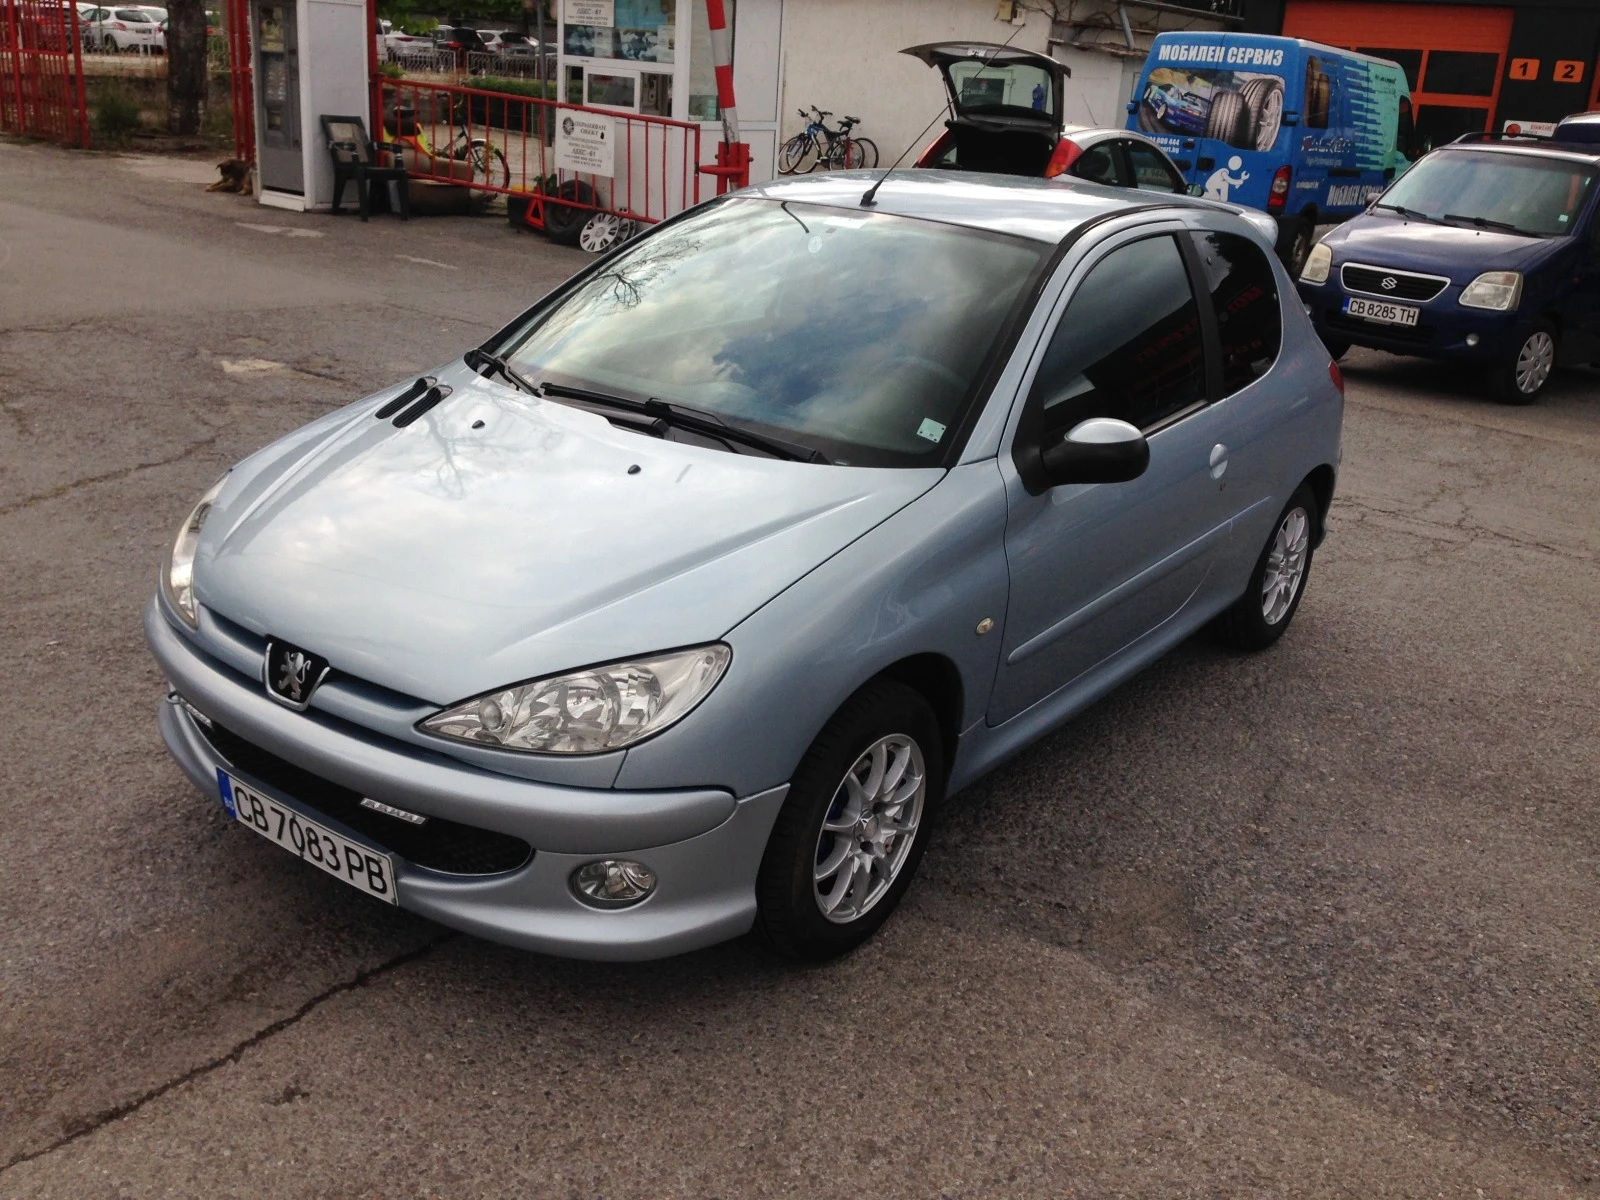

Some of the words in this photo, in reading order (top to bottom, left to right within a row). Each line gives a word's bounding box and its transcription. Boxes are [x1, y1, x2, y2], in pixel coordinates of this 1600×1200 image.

[1158, 44, 1226, 63] МОБИЛЕН
[1227, 46, 1284, 67] СЕРВИЗ
[1519, 62, 1529, 77] 1
[1561, 64, 1576, 79] 2
[1349, 300, 1365, 315] CB
[1367, 303, 1396, 320] 8285
[1400, 308, 1417, 323] TH
